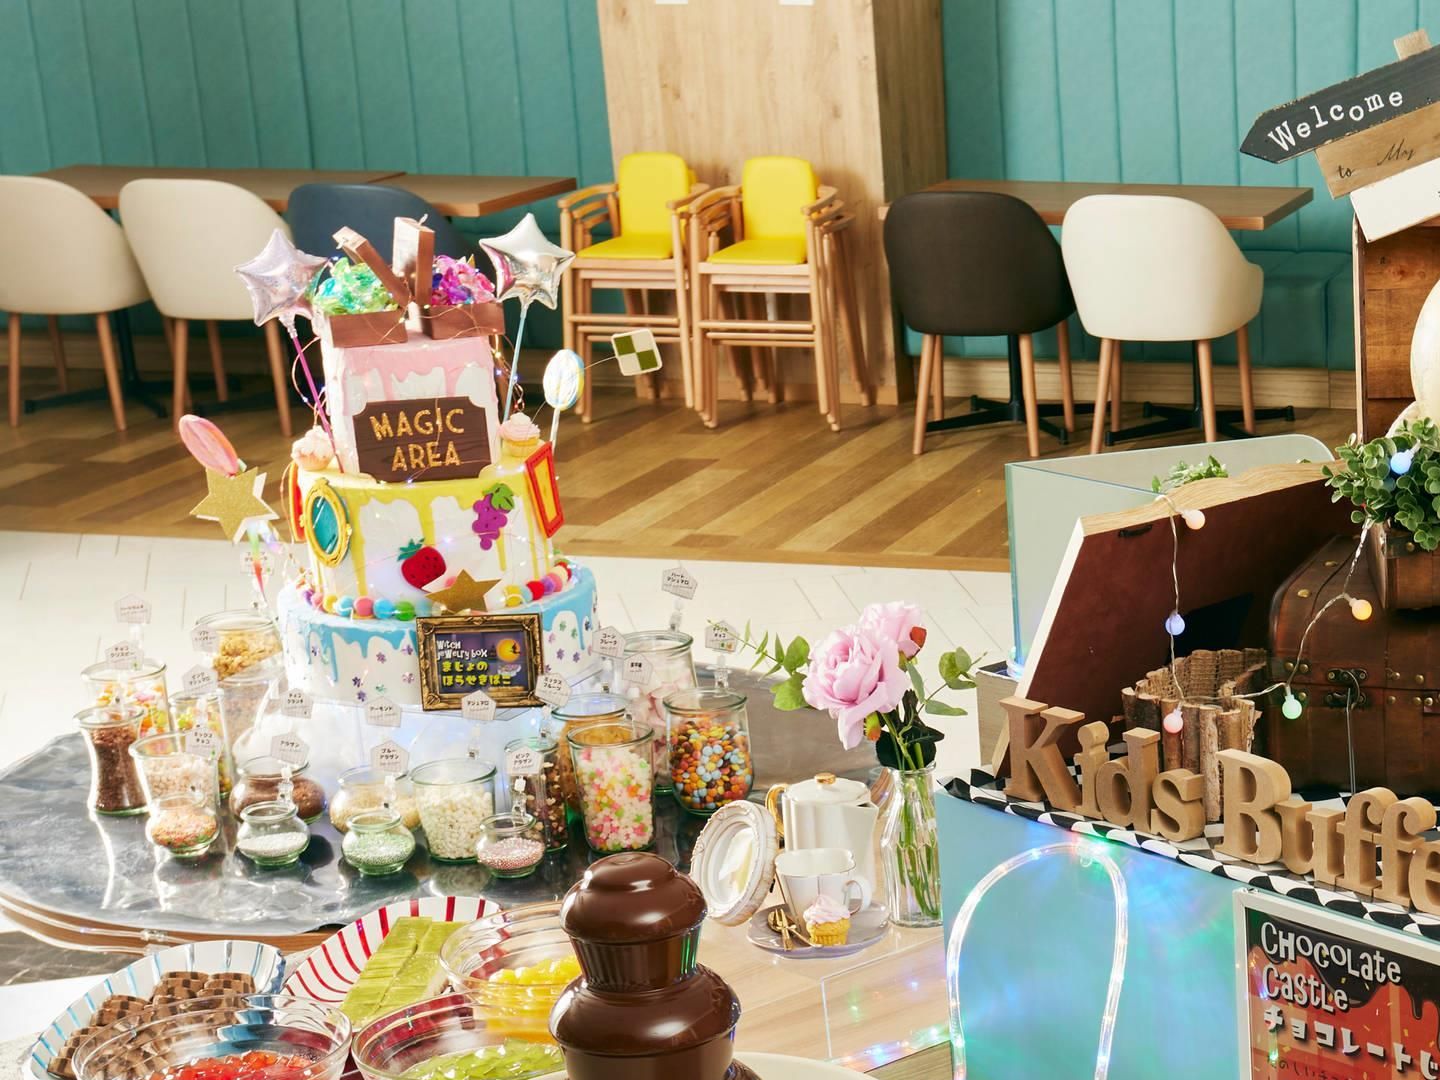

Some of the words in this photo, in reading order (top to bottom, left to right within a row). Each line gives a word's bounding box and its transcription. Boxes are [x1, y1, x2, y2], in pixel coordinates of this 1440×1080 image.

[1268, 90, 1403, 151] Welcome
[1336, 165, 1354, 178] to
[369, 408, 465, 440] MAGIC
[391, 441, 461, 471] AREA
[442, 661, 489, 672] まじょの
[442, 674, 511, 687] ほうせきばこ
[1000, 696, 1205, 842] Kids
